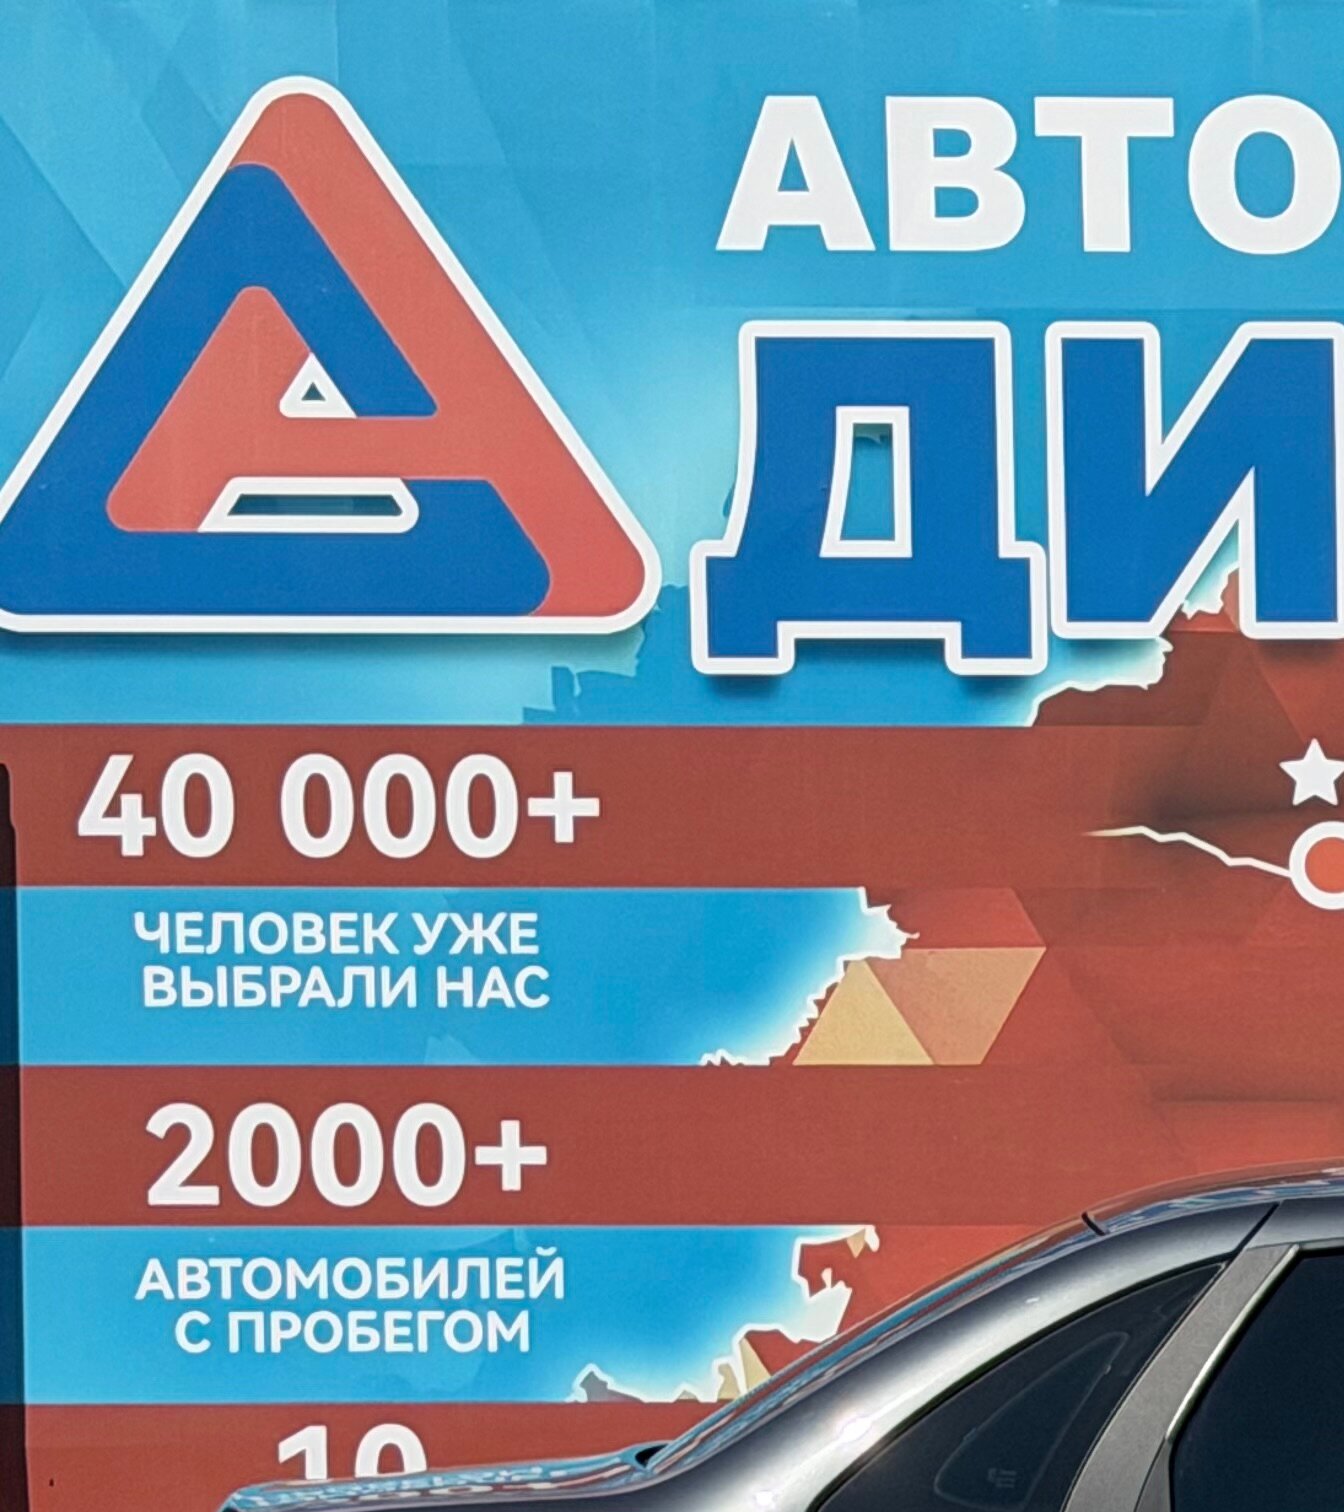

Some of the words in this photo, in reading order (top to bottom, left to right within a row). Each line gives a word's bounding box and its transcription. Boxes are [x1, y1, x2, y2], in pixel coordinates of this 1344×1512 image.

[77, 753, 234, 858] 40
[280, 753, 600, 859] 000+
[134, 912, 398, 954] ЧЕЛОВЕК
[412, 912, 539, 955] УЖЕ
[143, 965, 417, 1008] ВЫБРАЛИ
[437, 965, 549, 1009] НАС
[146, 1102, 548, 1207] 2000+
[135, 1248, 565, 1300] АВТОМОБИЛЕЙ
[175, 1311, 210, 1353] С
[228, 1310, 530, 1353] ПРОБЕГОМ
